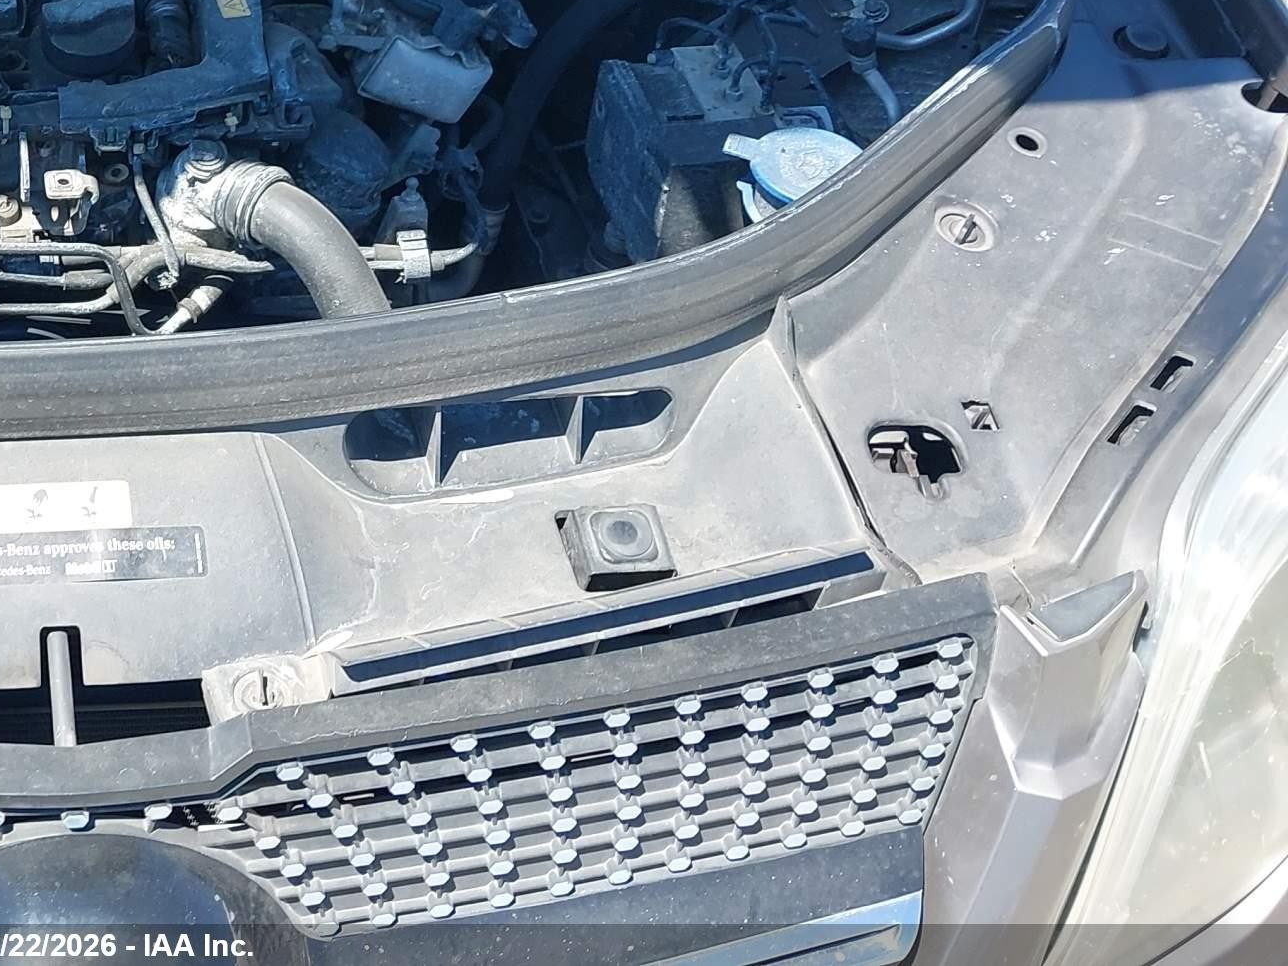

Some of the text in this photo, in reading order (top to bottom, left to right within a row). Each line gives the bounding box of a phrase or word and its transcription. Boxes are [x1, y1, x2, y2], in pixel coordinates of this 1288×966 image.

[43, 539, 104, 557] approves
[107, 537, 143, 552] these
[146, 536, 175, 551] oils:
